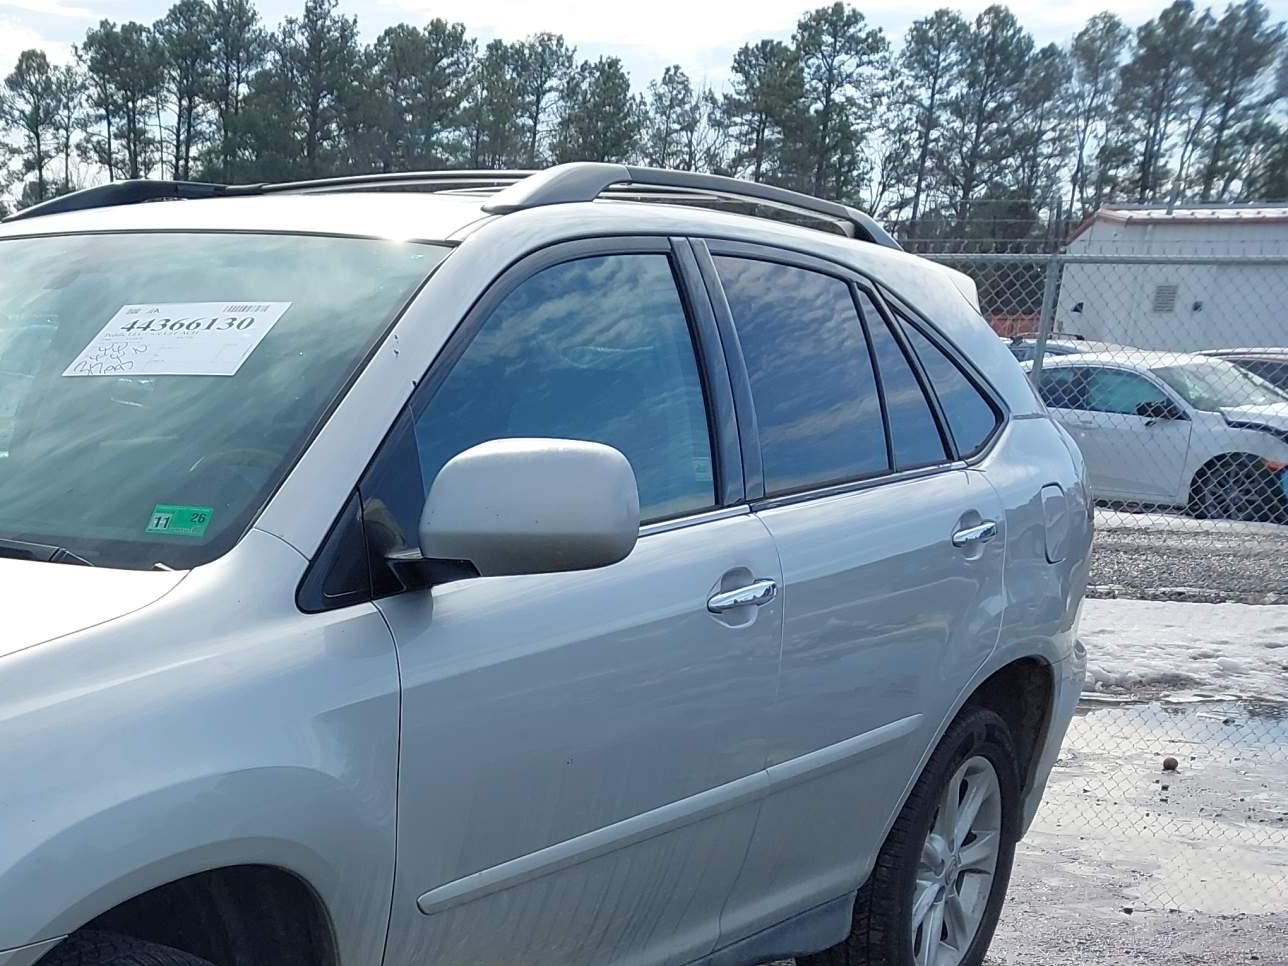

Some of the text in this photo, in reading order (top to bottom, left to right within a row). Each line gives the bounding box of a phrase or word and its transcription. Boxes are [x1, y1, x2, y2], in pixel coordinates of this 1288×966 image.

[120, 316, 256, 333] 44366130
[154, 516, 171, 529] 11
[191, 512, 207, 524] 26
